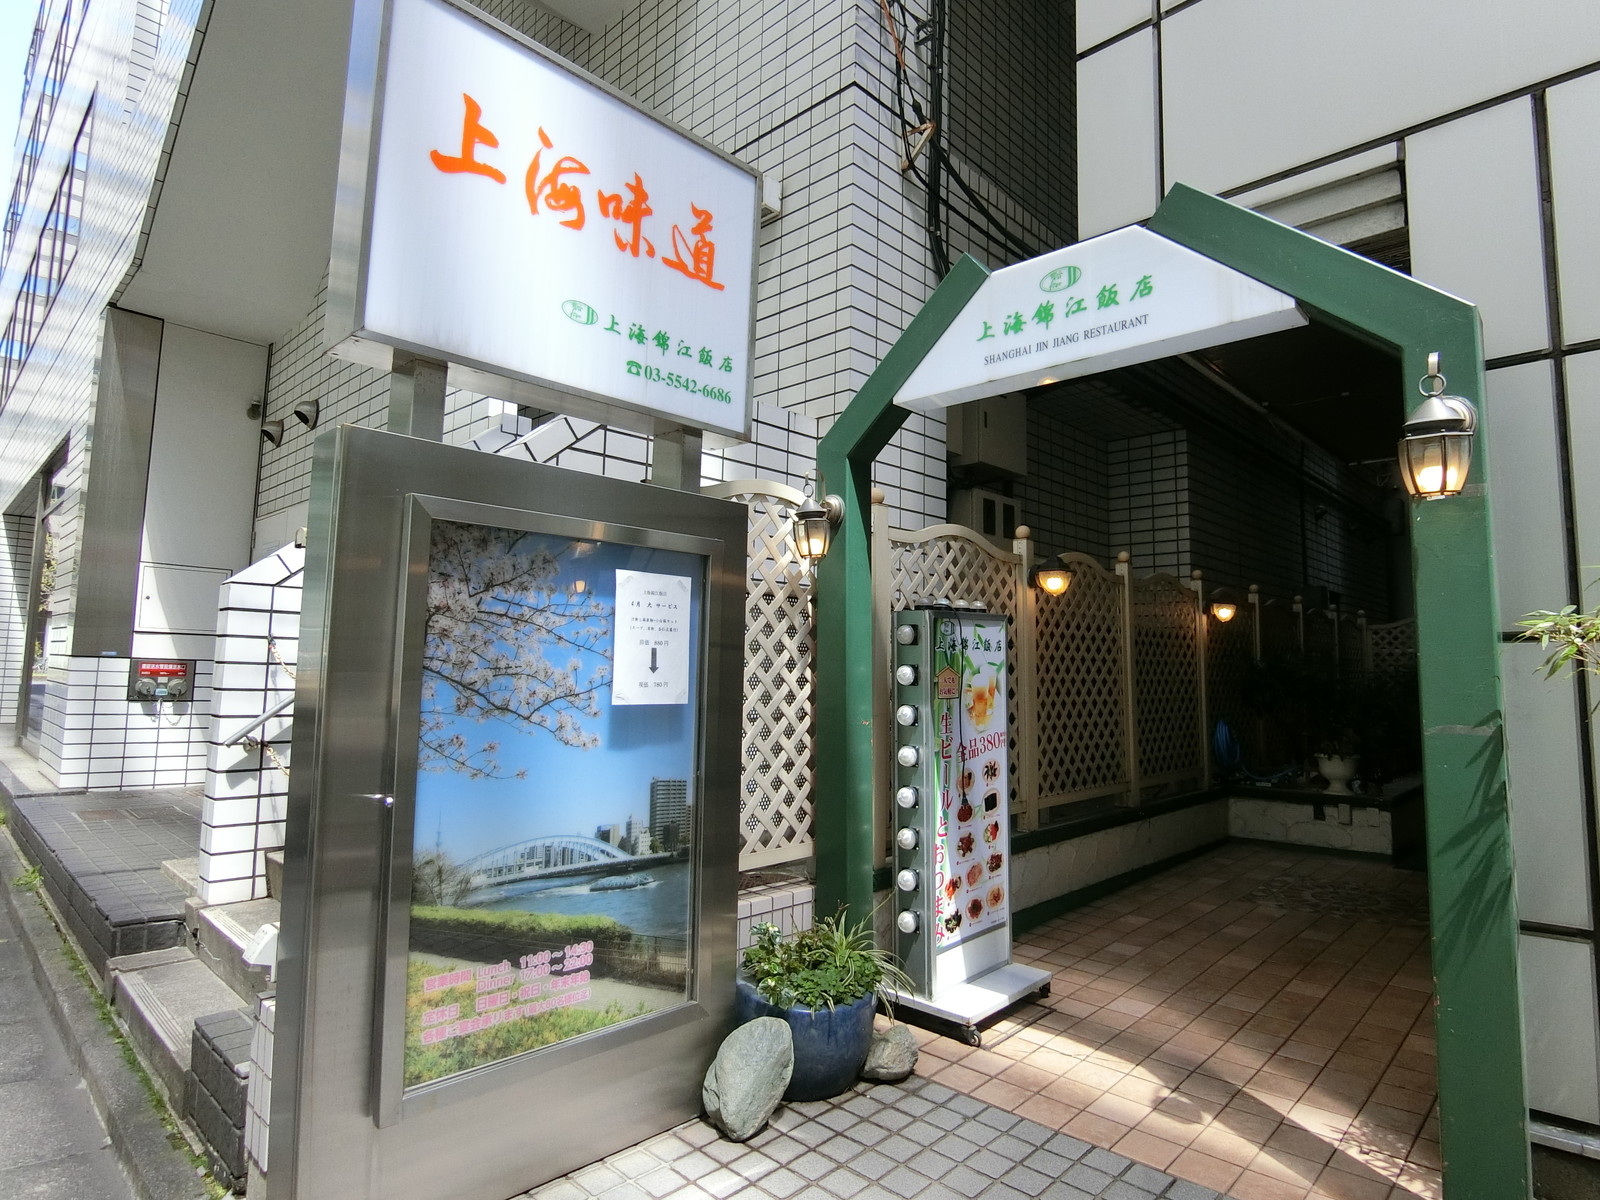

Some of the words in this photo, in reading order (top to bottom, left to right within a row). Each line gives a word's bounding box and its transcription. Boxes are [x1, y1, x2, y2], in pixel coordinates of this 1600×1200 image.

[430, 92, 725, 291] 上海味道
[976, 274, 1154, 342] 上海錦江飯店
[603, 314, 733, 373] 上海錦江飯店
[983, 349, 1032, 366] SHANGHAI
[1035, 340, 1049, 353] JIN
[1052, 332, 1080, 349] JIANG
[1083, 313, 1149, 341] RESTAURANT
[644, 365, 732, 404] 03-5542-6686
[476, 959, 512, 980] Lunch
[476, 973, 515, 993] Dinner
[422, 1003, 460, 1026] 定休日
